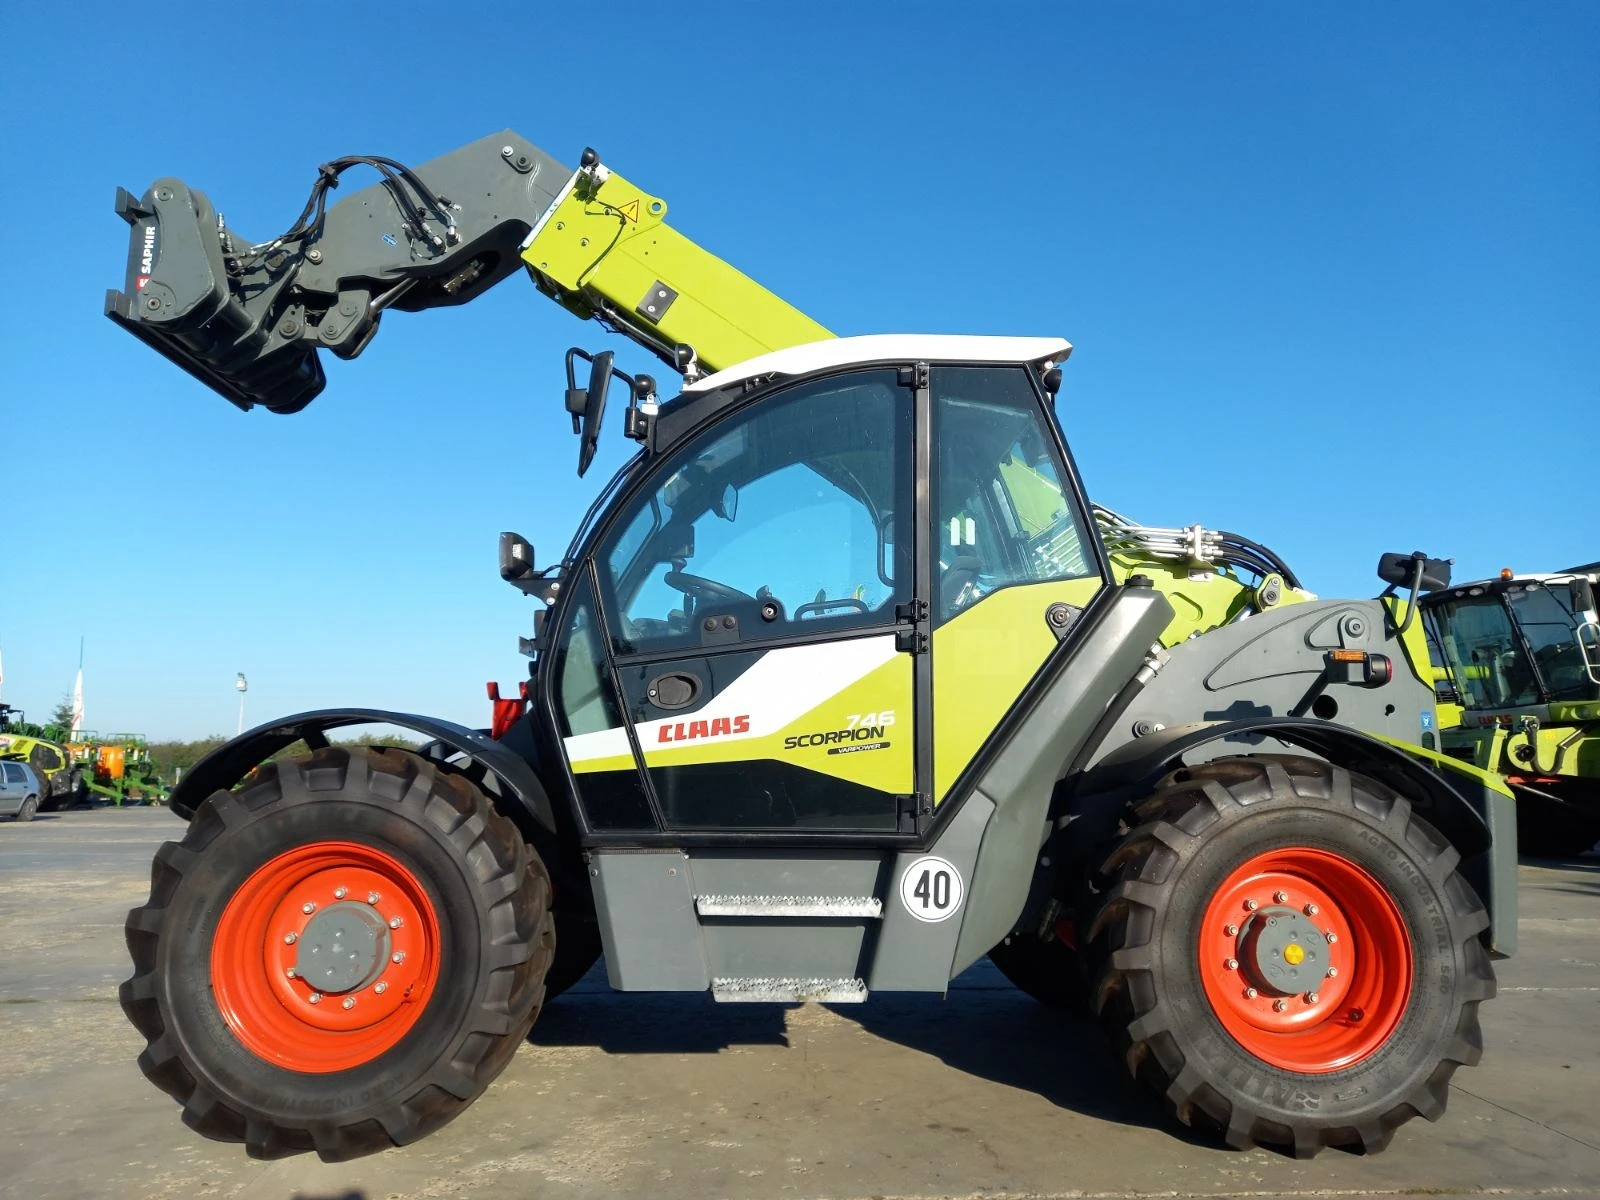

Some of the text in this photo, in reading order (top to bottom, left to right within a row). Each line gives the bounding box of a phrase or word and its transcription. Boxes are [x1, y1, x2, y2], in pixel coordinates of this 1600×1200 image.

[141, 226, 156, 274] SAPHIR
[658, 715, 750, 743] CLAAS
[846, 710, 896, 731] 746
[784, 725, 885, 750] SCORPION
[838, 743, 881, 754] VARIPOWER
[914, 870, 951, 910] 40
[1358, 830, 1398, 861] AGRO
[1399, 861, 1449, 953] INDUSTRIAL
